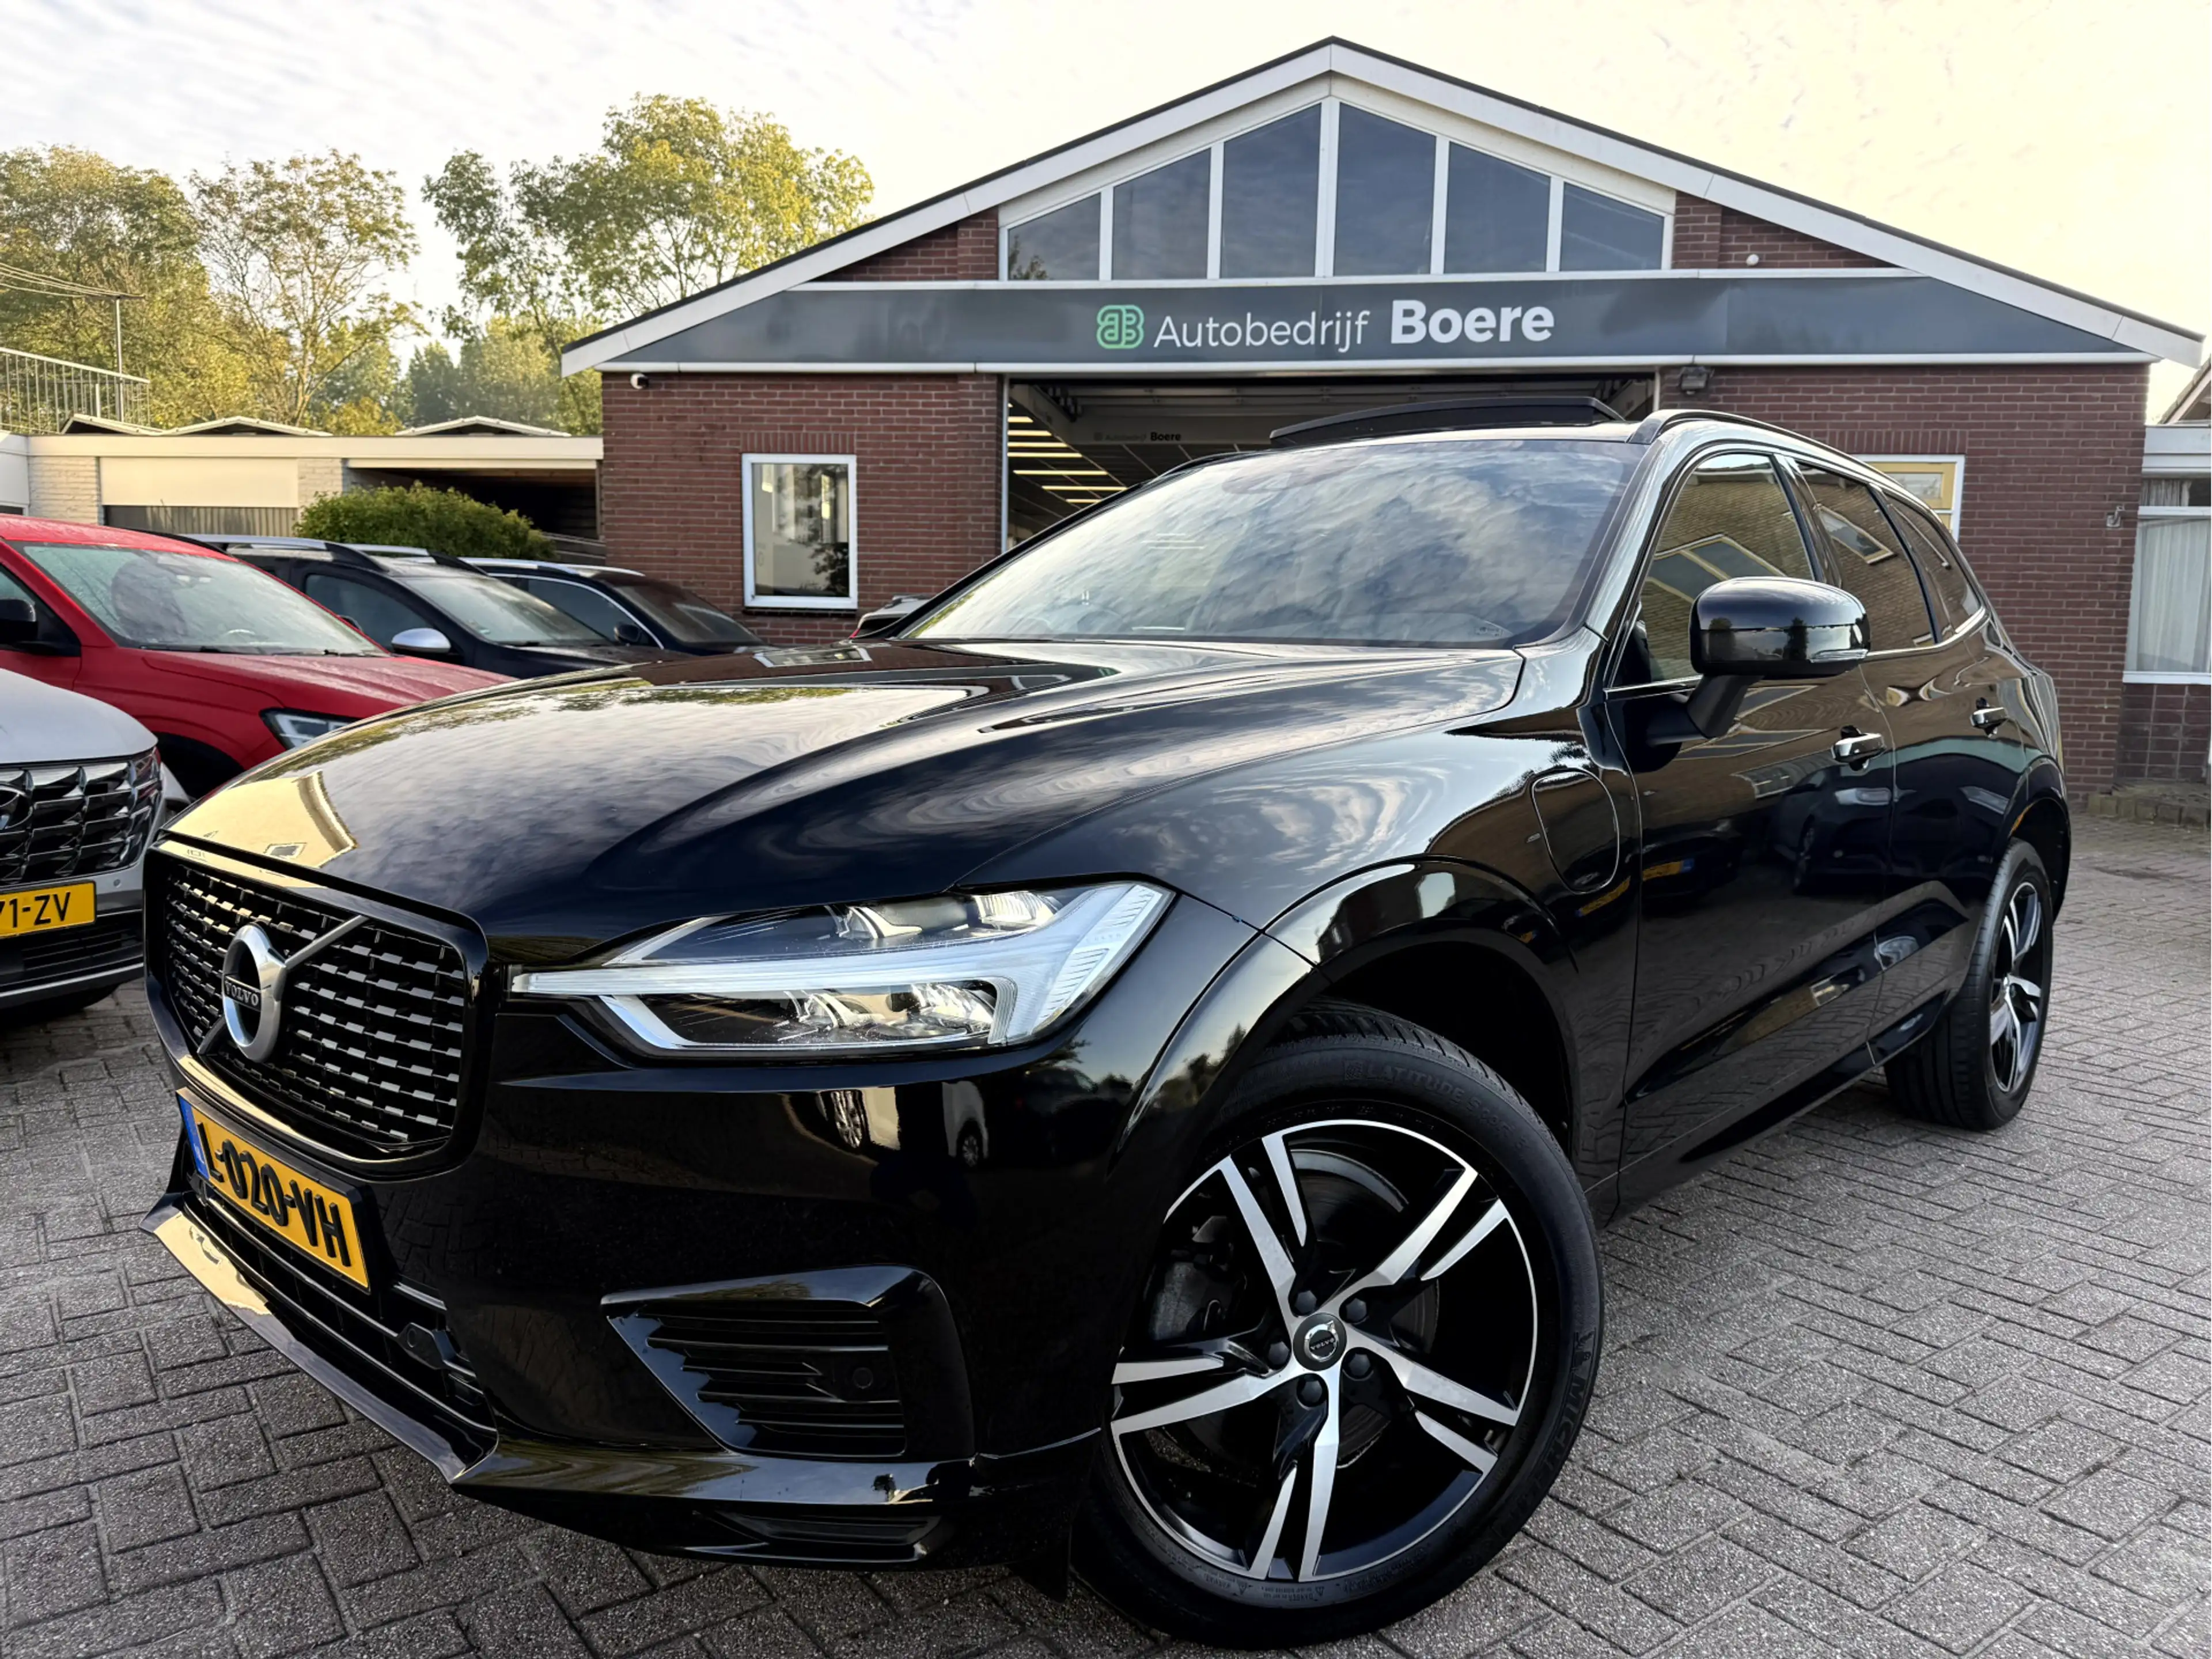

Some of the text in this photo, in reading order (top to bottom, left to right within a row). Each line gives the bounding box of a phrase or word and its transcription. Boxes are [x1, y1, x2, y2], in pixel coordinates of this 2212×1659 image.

[1153, 300, 1555, 353] Autobedrijf Boere
[1150, 431, 1181, 441] Boere
[225, 980, 259, 1006] VOLVO
[1368, 1066, 1465, 1098] LATITUDE
[198, 1122, 351, 1267] L-020-VH
